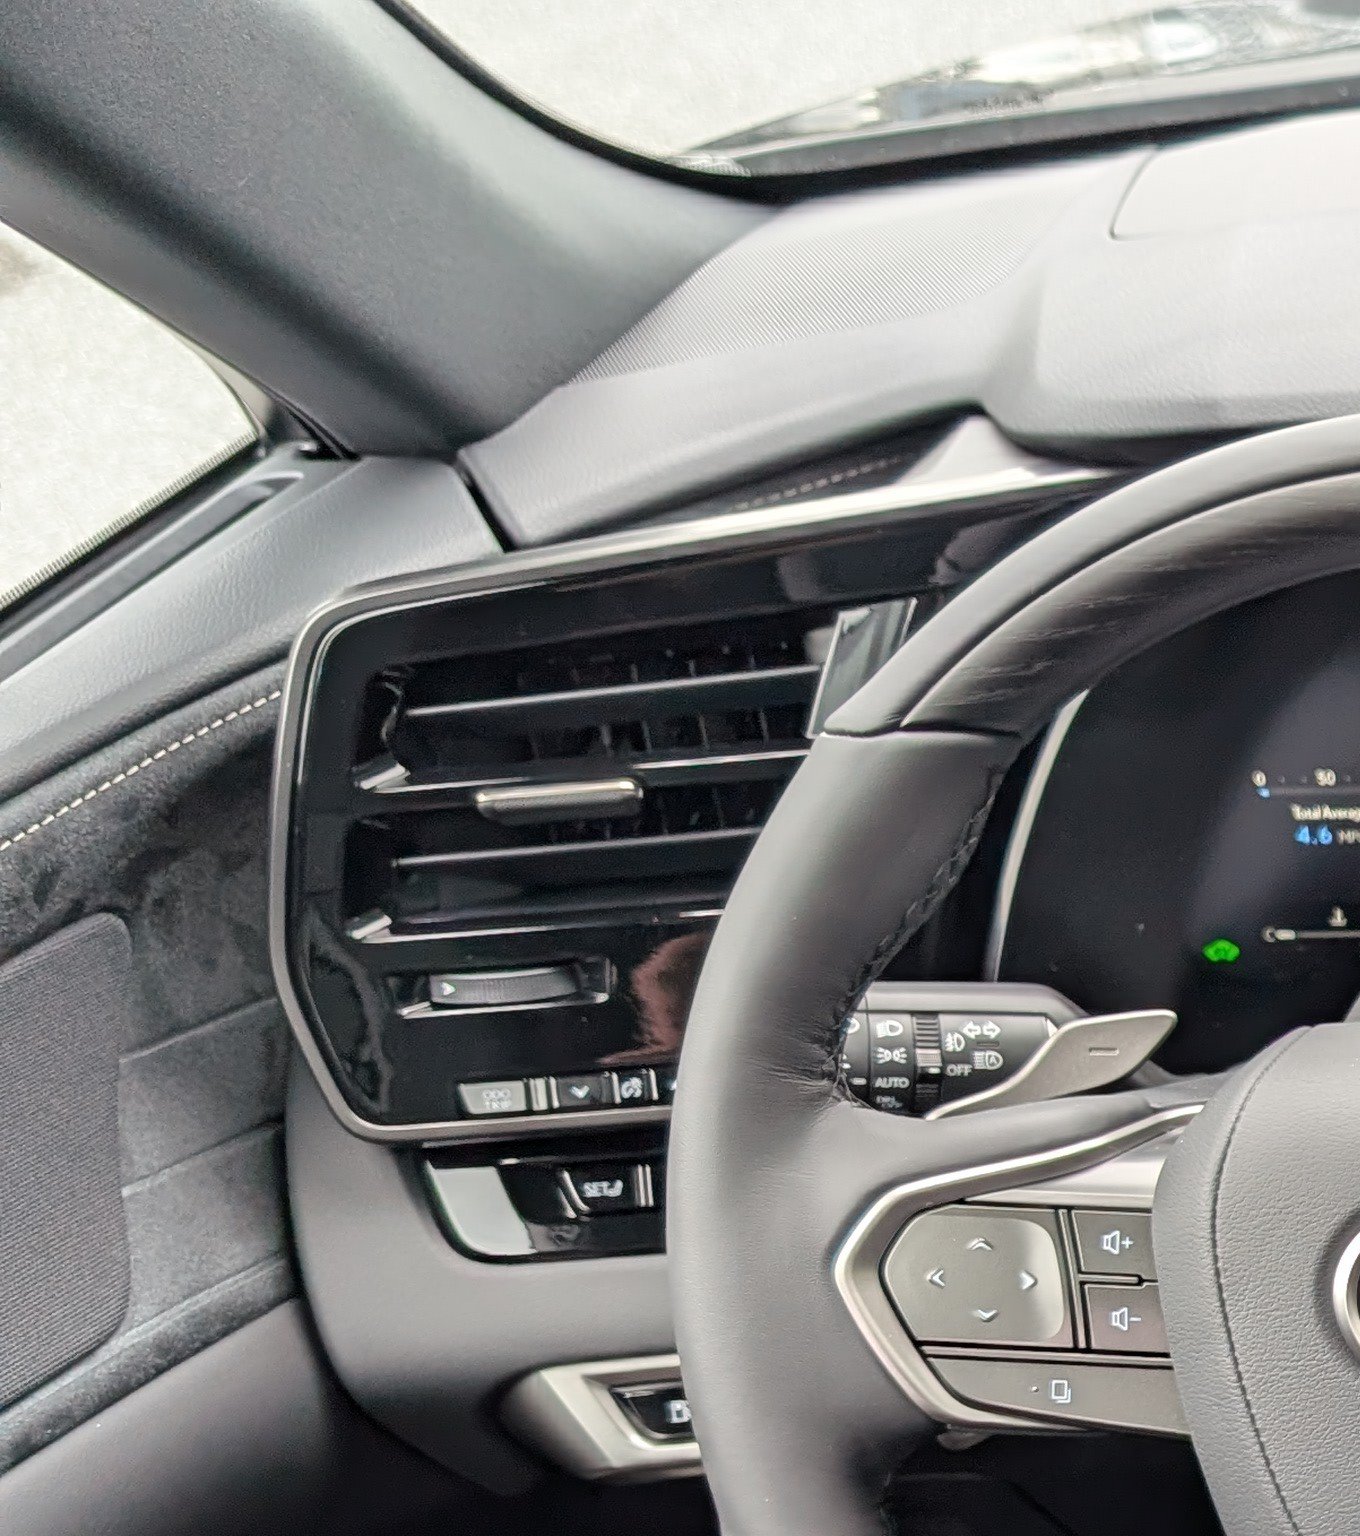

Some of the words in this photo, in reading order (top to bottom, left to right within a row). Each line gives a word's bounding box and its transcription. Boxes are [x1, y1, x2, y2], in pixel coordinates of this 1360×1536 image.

[1251, 769, 1267, 787] 0
[945, 1063, 974, 1077] OFF
[874, 1076, 911, 1090] AUTO
